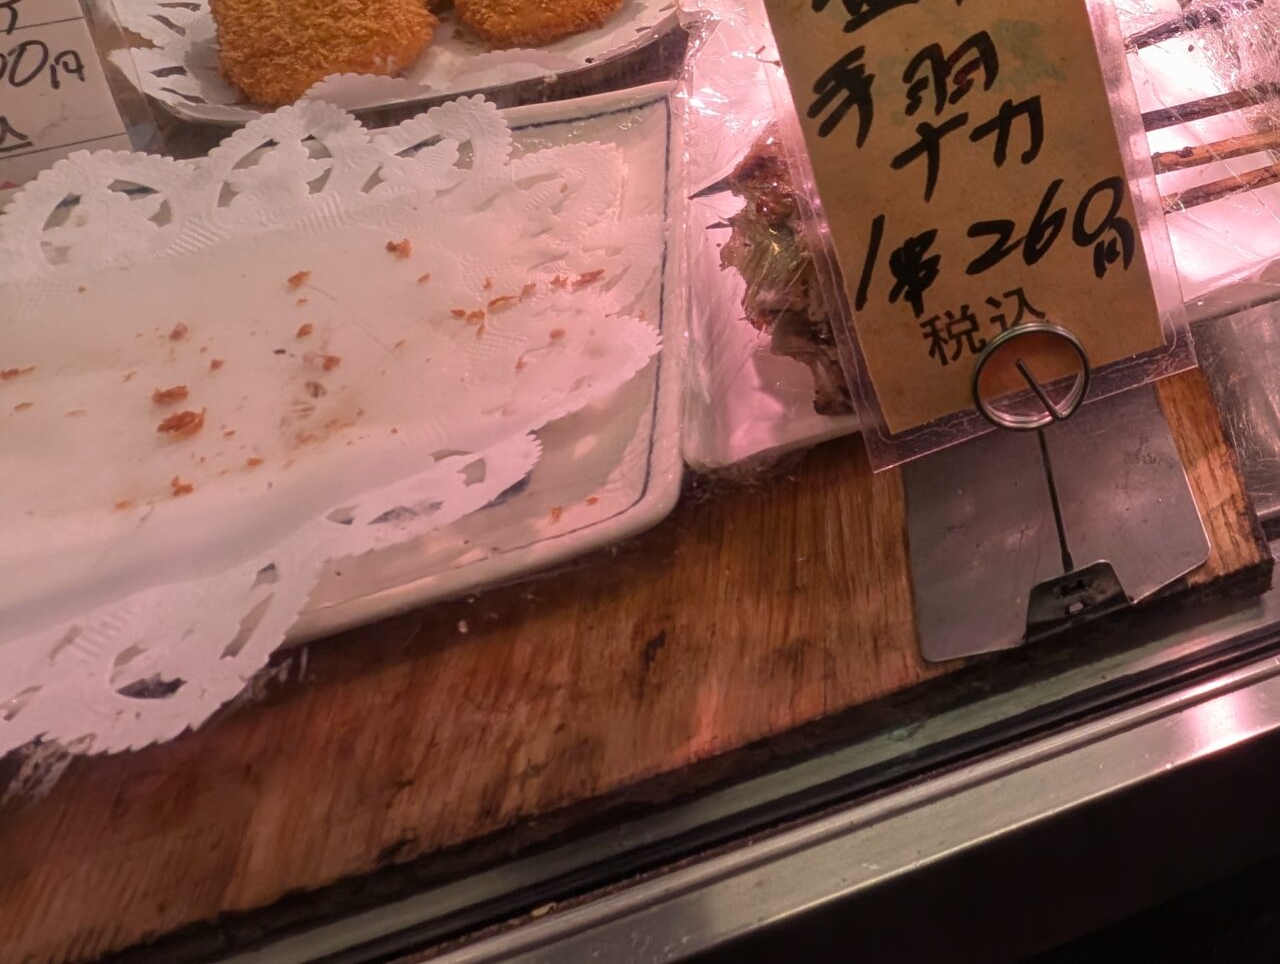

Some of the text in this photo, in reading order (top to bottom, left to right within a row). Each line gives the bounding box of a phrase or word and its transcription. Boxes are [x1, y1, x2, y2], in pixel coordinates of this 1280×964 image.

[808, 30, 999, 148] 手羽
[890, 95, 1045, 204] ナカ
[966, 175, 1136, 279] 260円
[921, 287, 1048, 367] 税込
